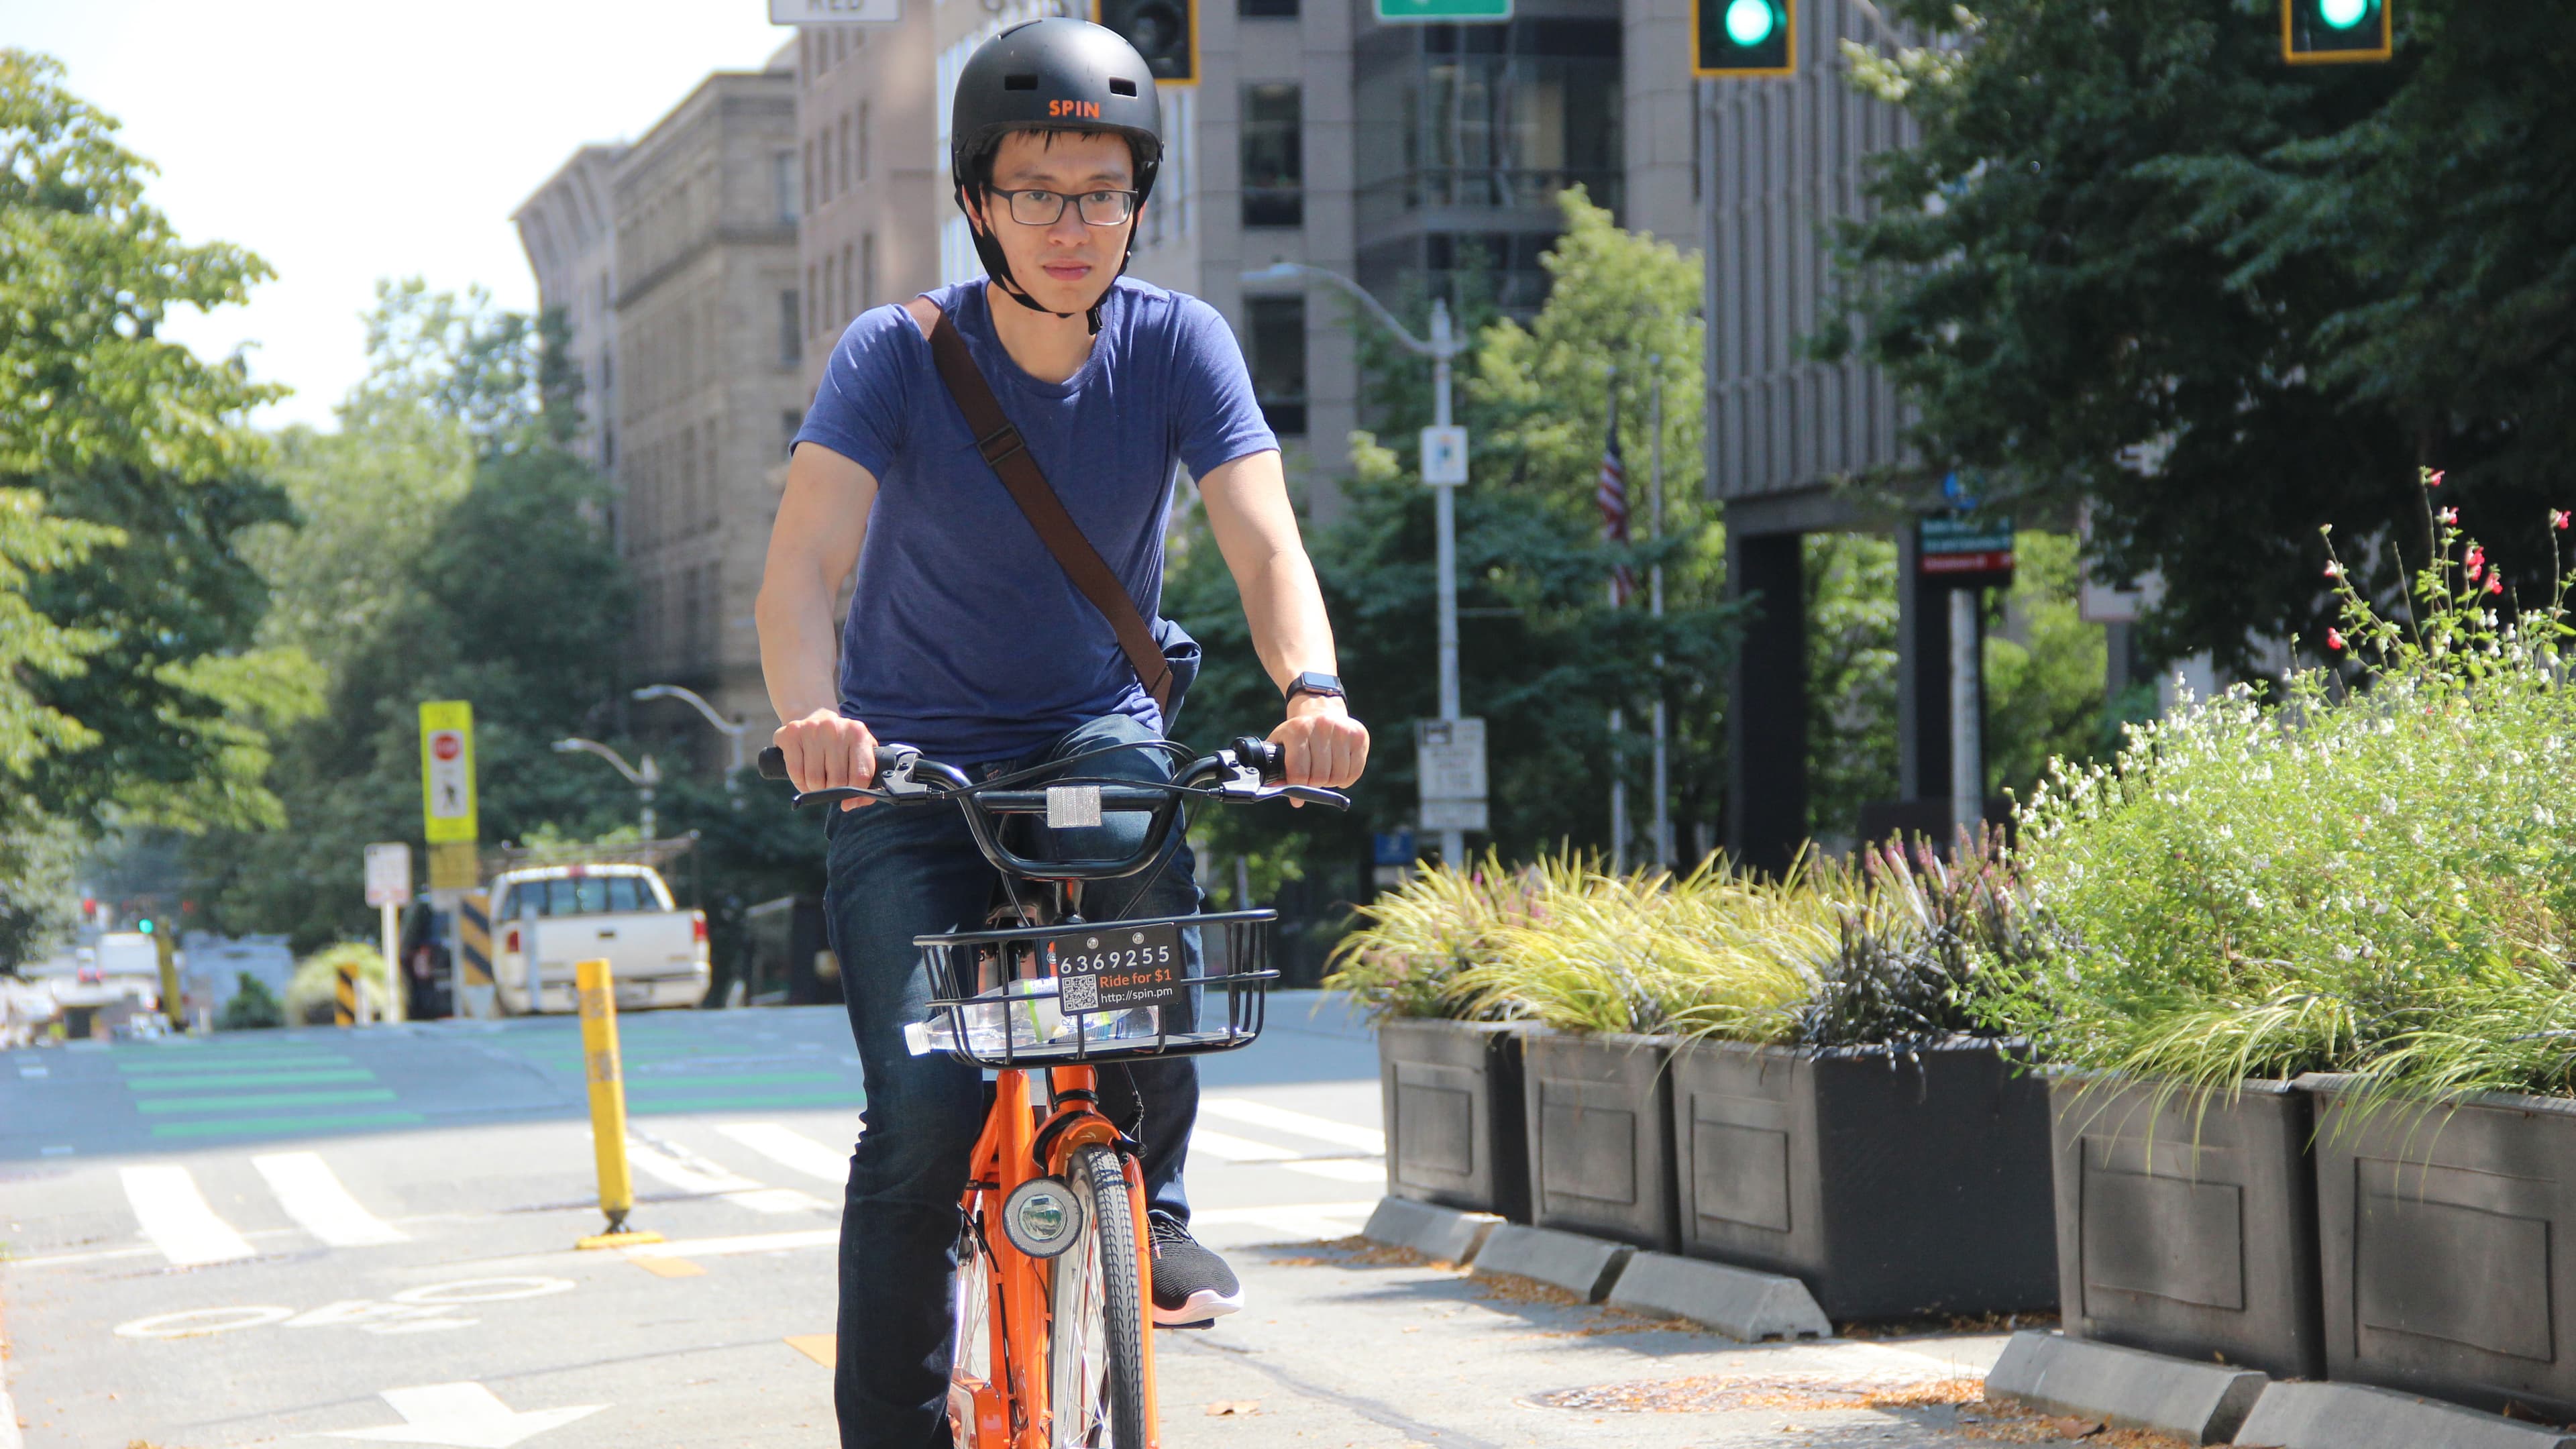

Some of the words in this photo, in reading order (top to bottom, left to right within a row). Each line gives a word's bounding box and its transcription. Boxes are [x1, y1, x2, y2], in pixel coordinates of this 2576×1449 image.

[1049, 100, 1099, 119] SPIN
[1061, 945, 1169, 973] 6369255
[1099, 975, 1130, 987] Ride
[1132, 973, 1152, 985] for
[1155, 969, 1172, 982] $1
[1101, 987, 1173, 1004] http://spin.pm
